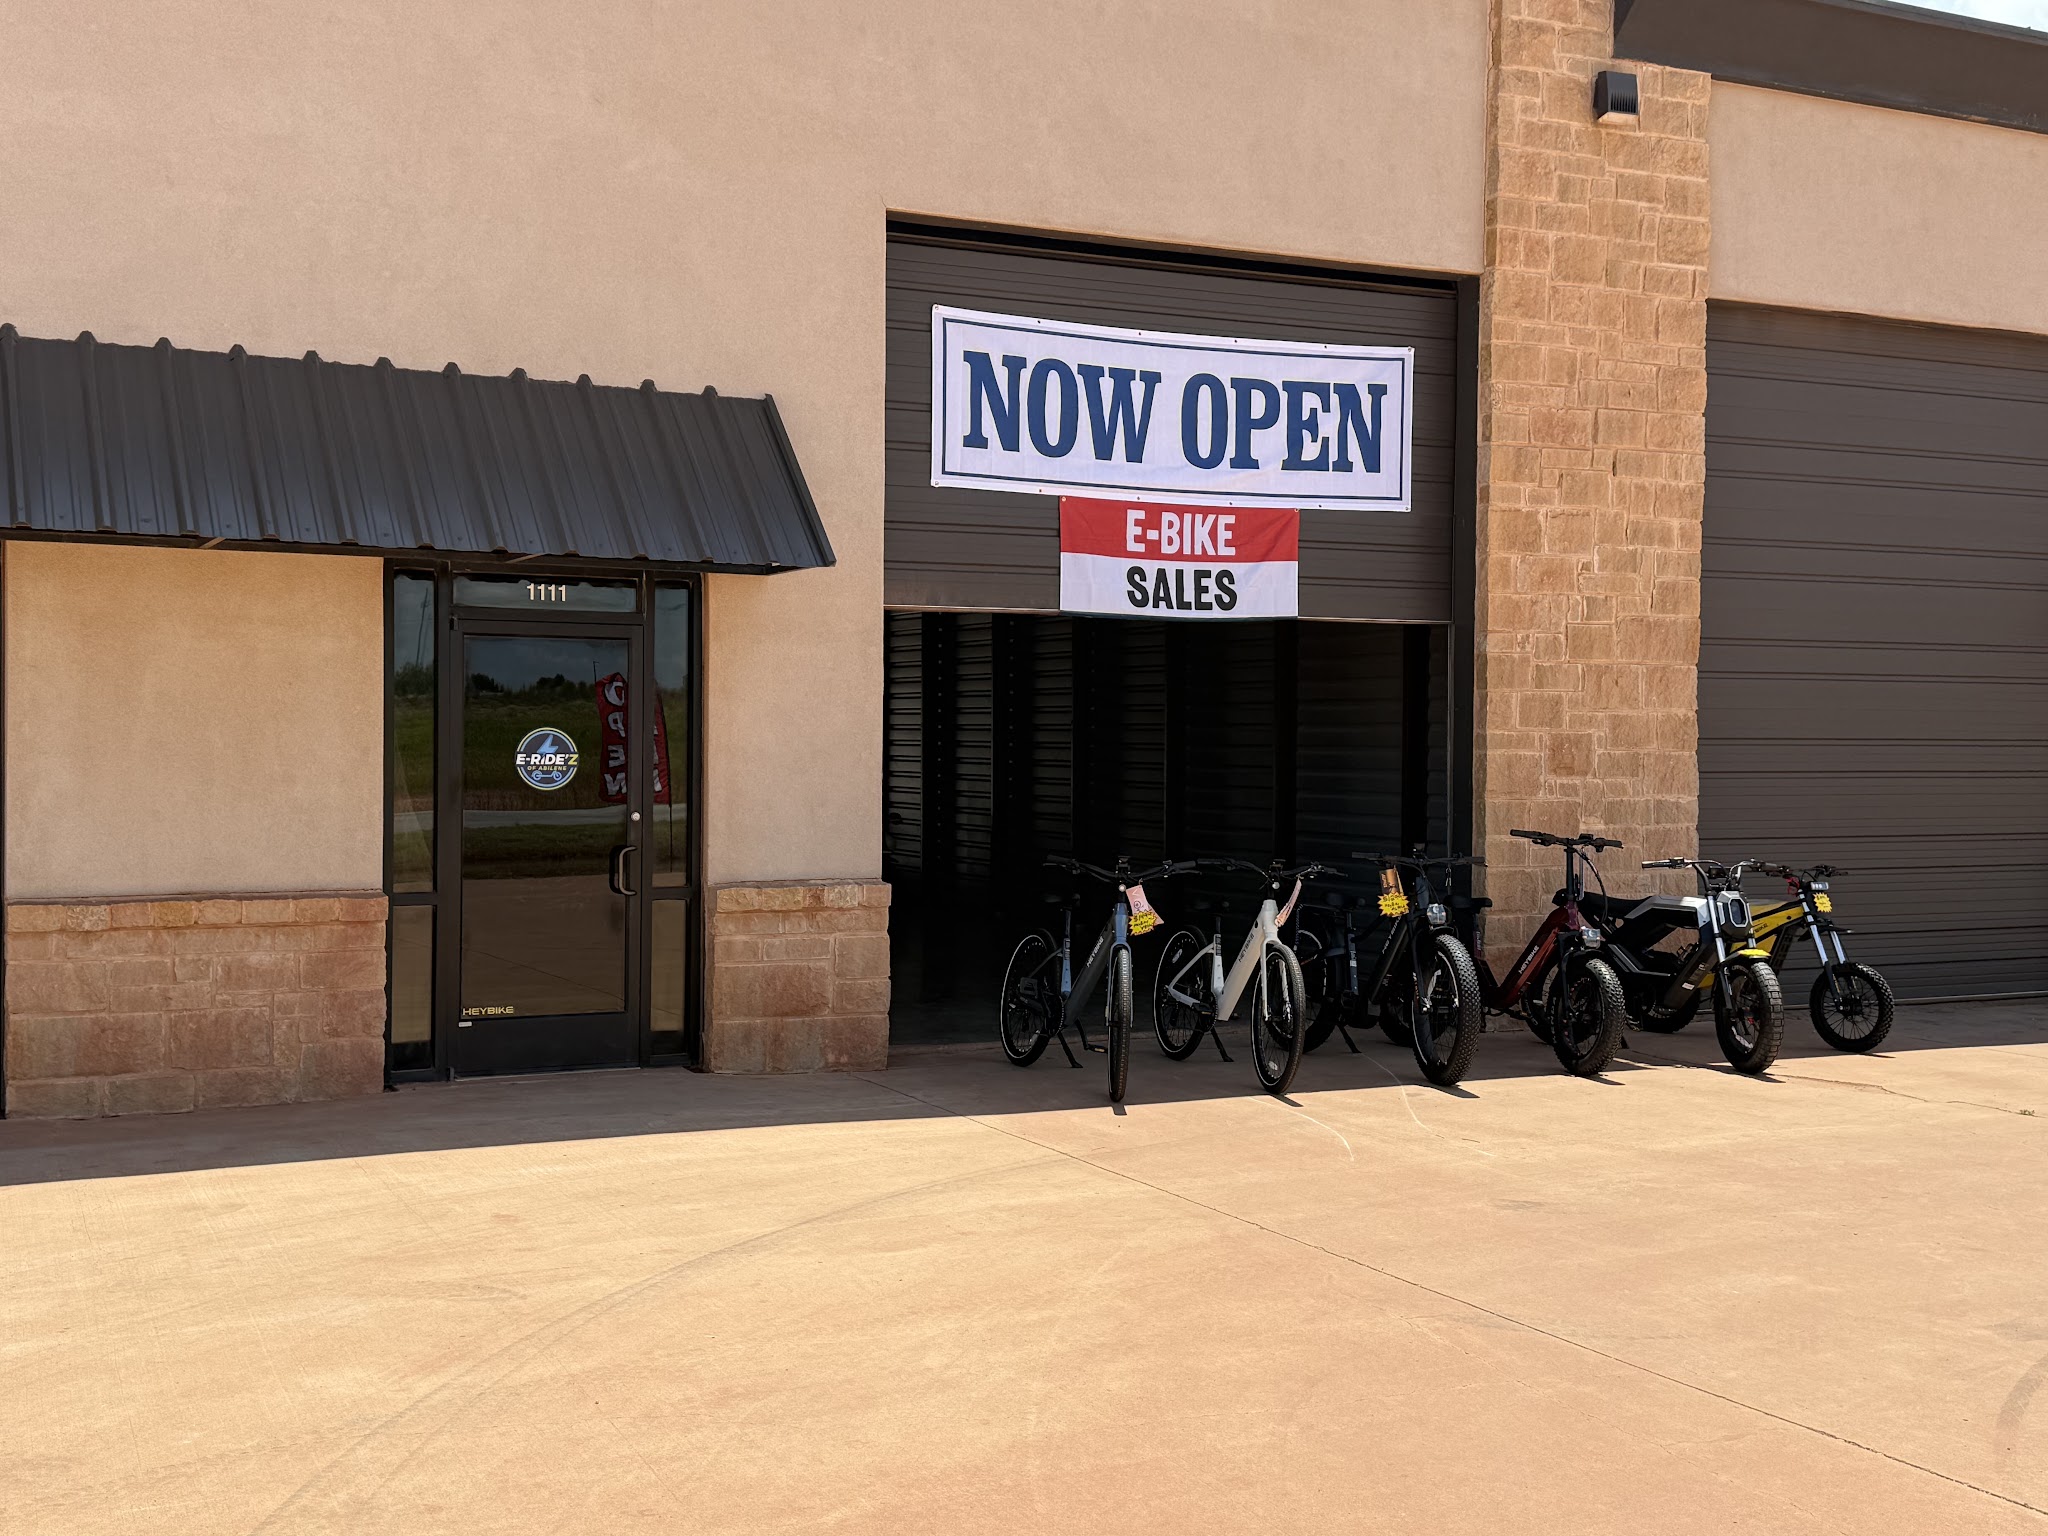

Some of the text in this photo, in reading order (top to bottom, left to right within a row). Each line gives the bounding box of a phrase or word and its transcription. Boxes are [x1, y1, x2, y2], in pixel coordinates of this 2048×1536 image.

[962, 351, 1388, 474] NOW OPEN
[1126, 509, 1236, 556] E-BIKE
[526, 583, 566, 602] 1111
[1126, 565, 1238, 611] SALES
[1518, 945, 1540, 974] HEYBIKE
[462, 1006, 514, 1016] HEYBIKE
